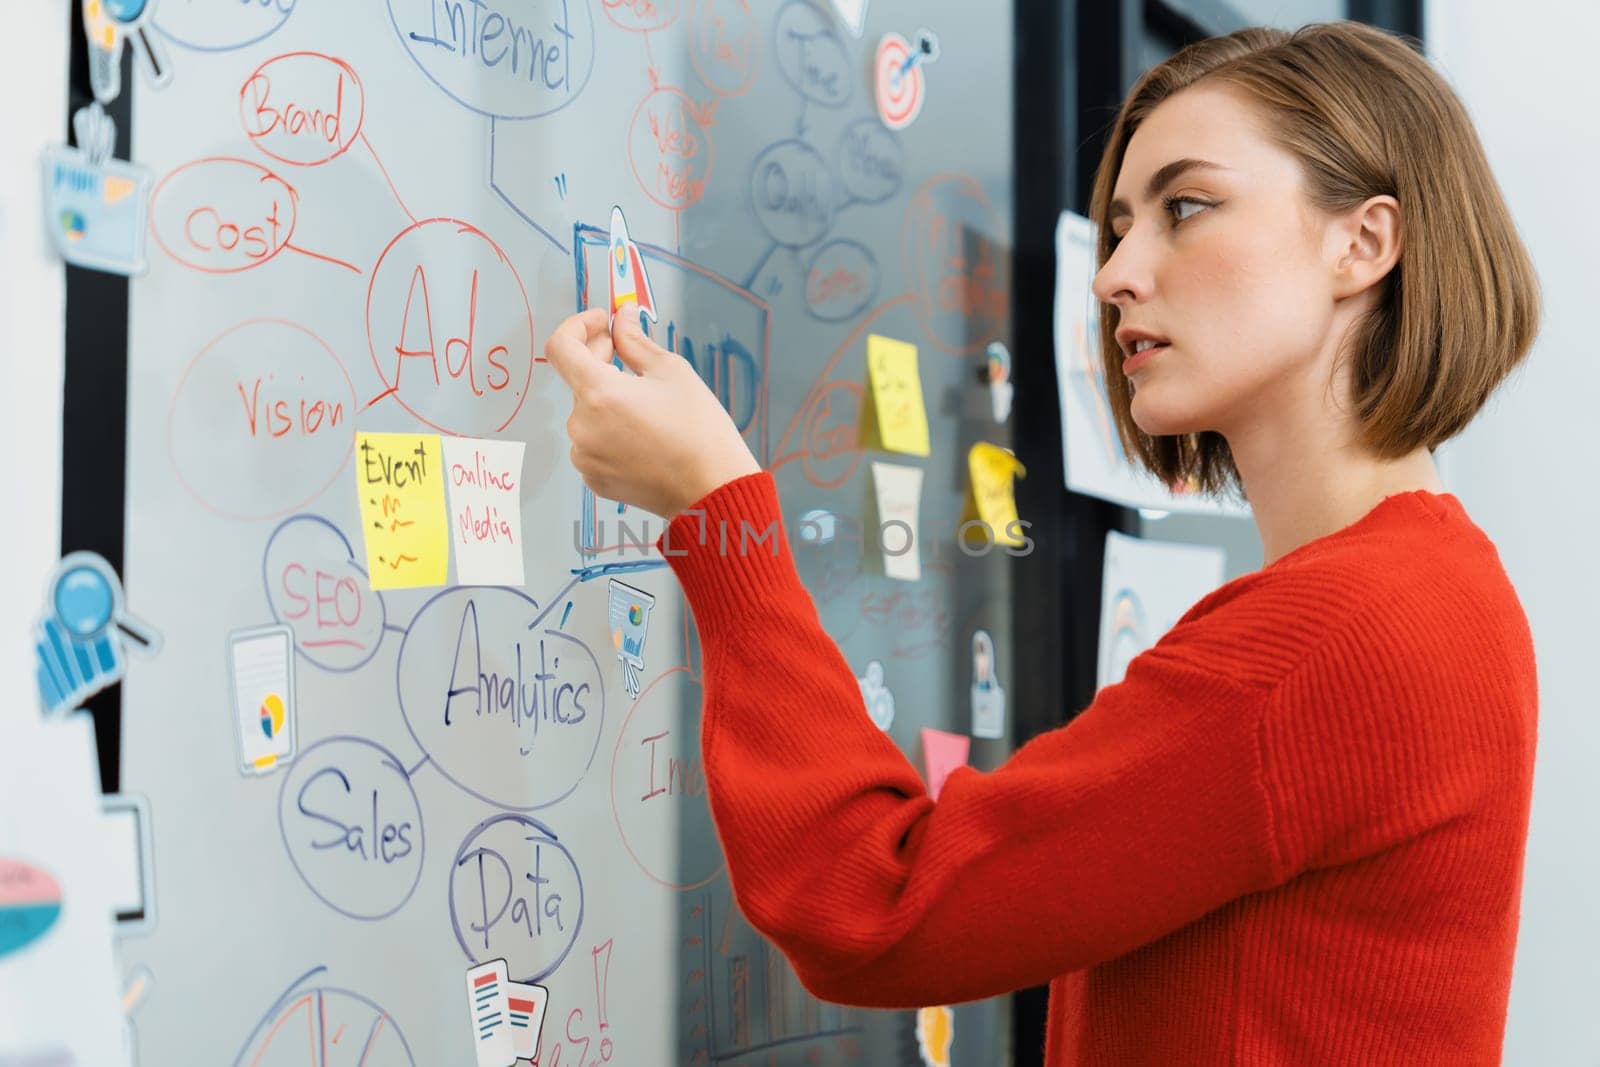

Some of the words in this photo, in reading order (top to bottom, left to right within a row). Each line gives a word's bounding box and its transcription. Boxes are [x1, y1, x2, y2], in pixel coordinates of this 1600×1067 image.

[248, 72, 345, 152] Brand
[184, 200, 281, 259] Cost
[237, 373, 344, 437] Vision
[361, 439, 427, 488] Event
[459, 505, 514, 544] Media
[282, 562, 363, 629] SEO
[444, 599, 591, 756] Analytics
[298, 767, 412, 865] Sales
[459, 844, 564, 949] Data
